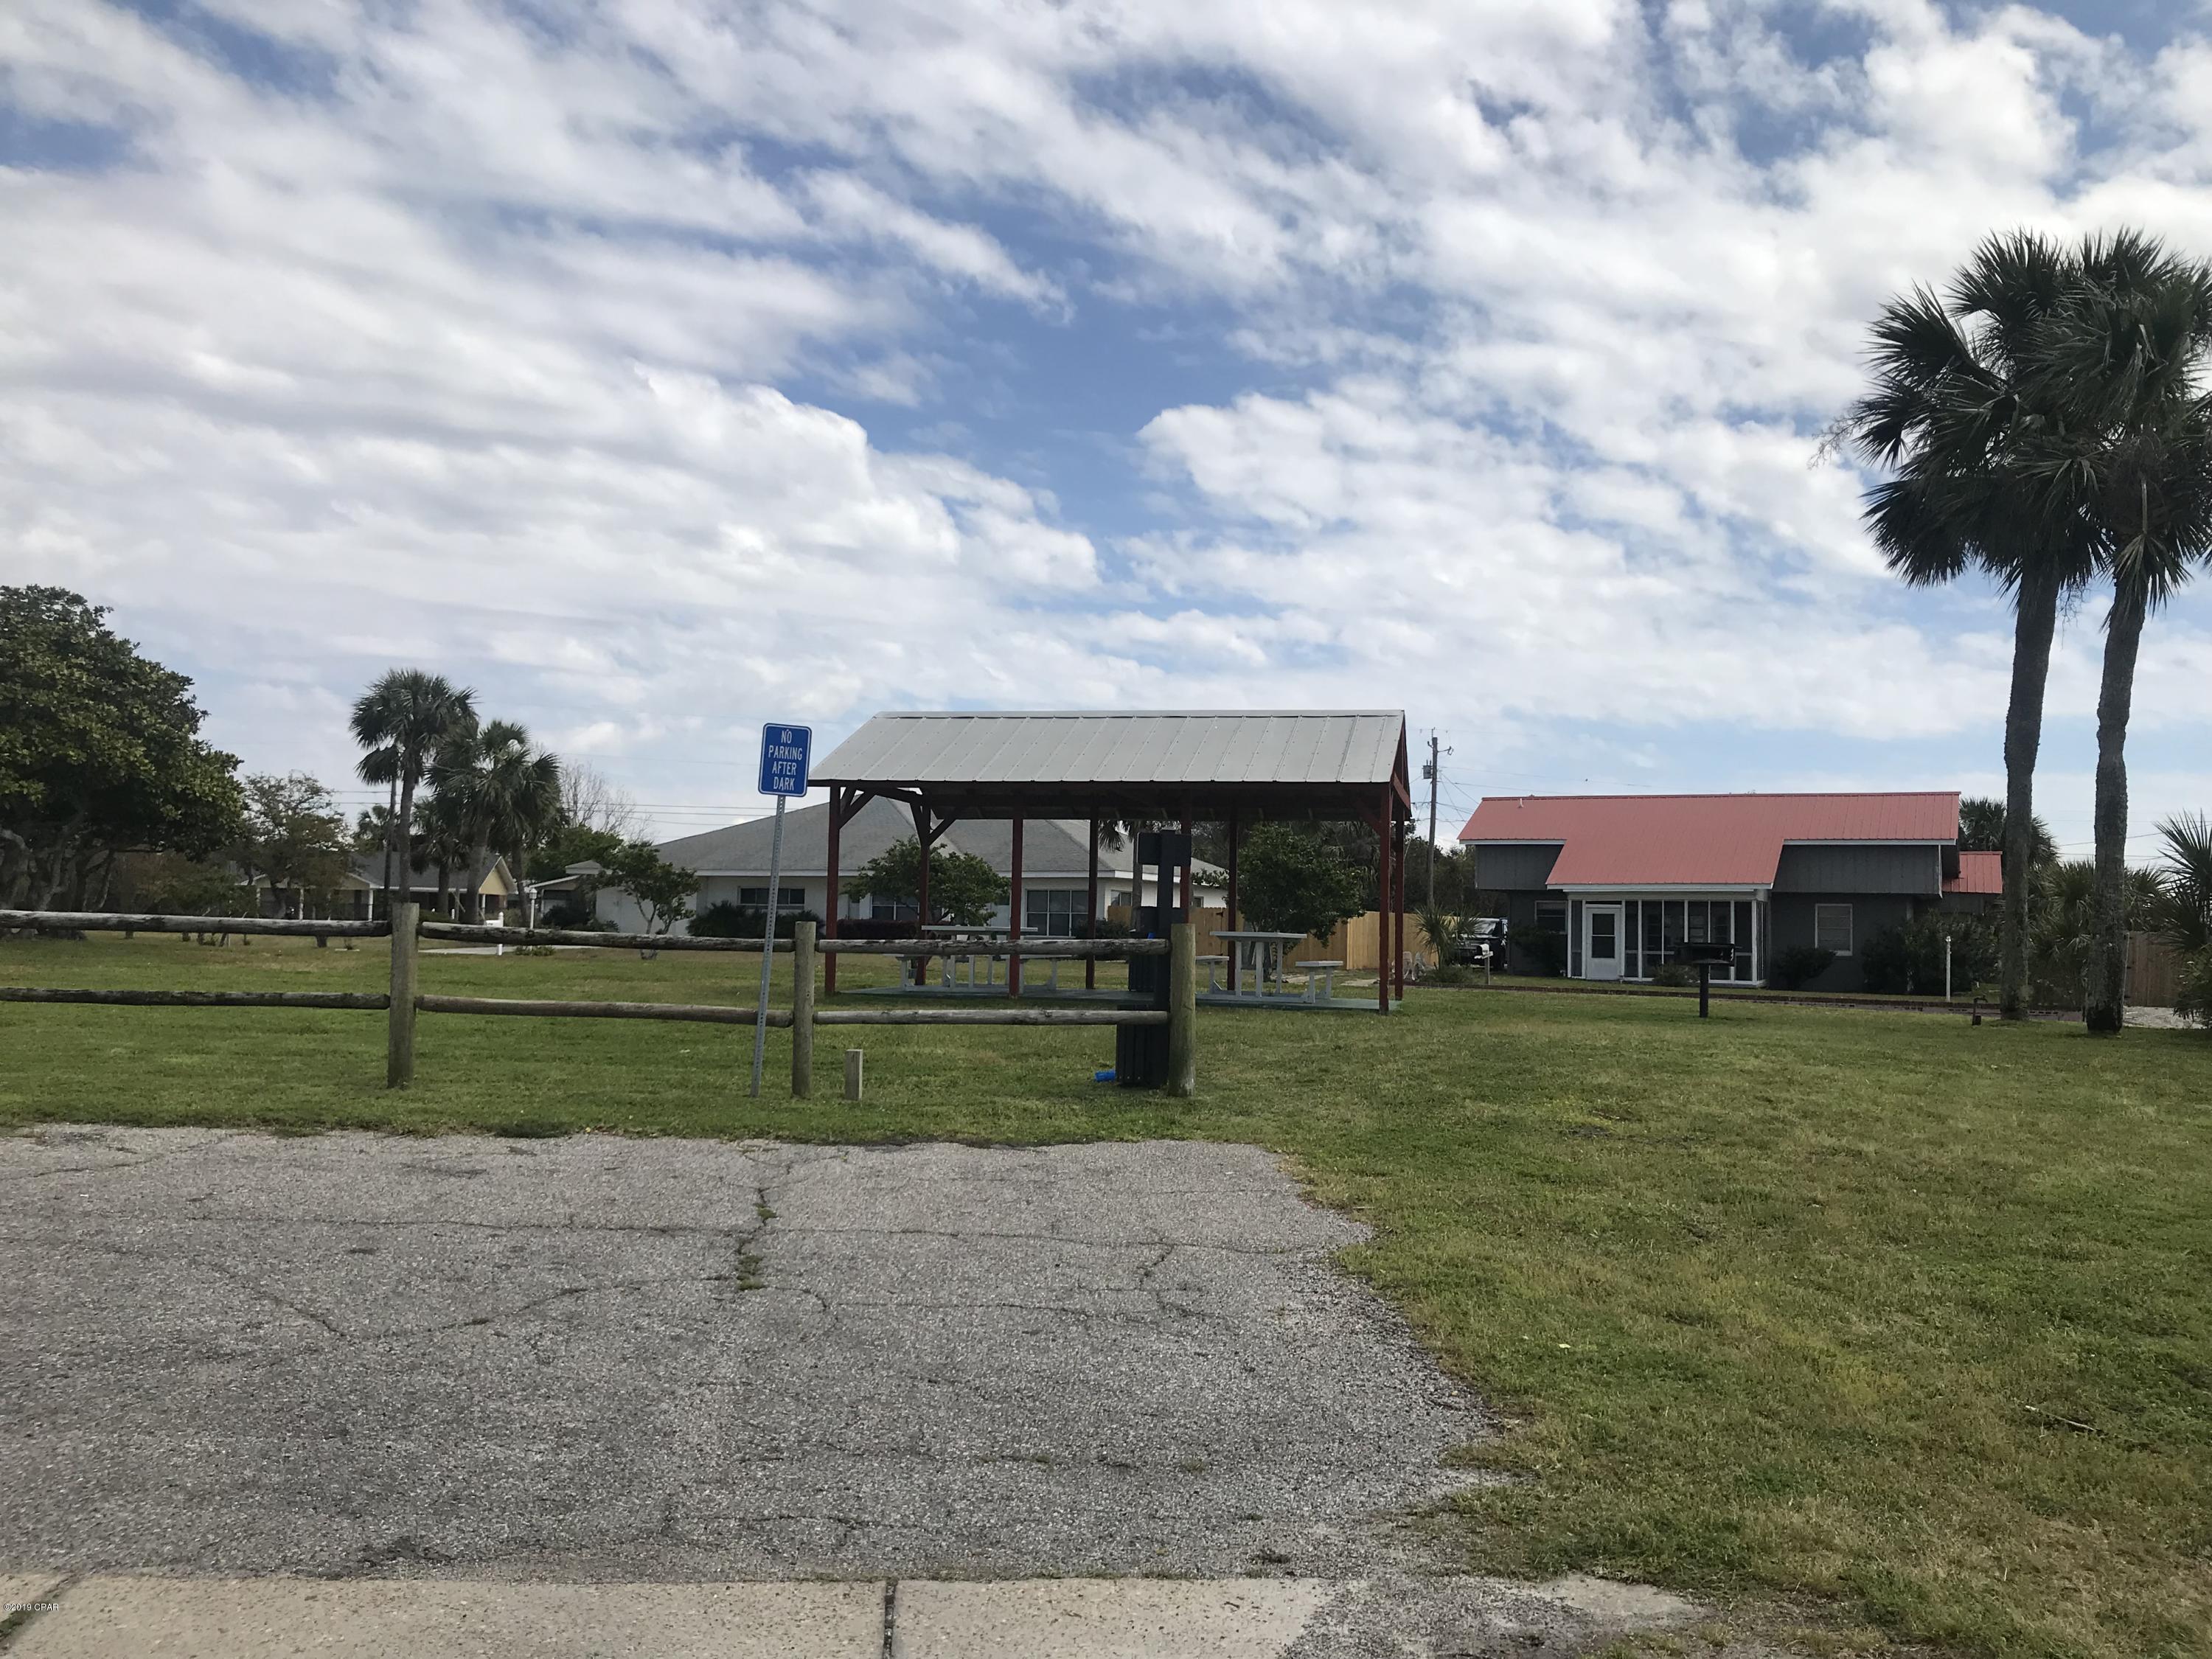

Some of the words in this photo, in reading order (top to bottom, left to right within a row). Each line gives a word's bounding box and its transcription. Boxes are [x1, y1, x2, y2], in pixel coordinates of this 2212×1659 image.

[781, 730, 792, 743] NO
[768, 745, 802, 760] PARKING
[772, 761, 796, 775] AFTER
[773, 776, 795, 790] DARK
